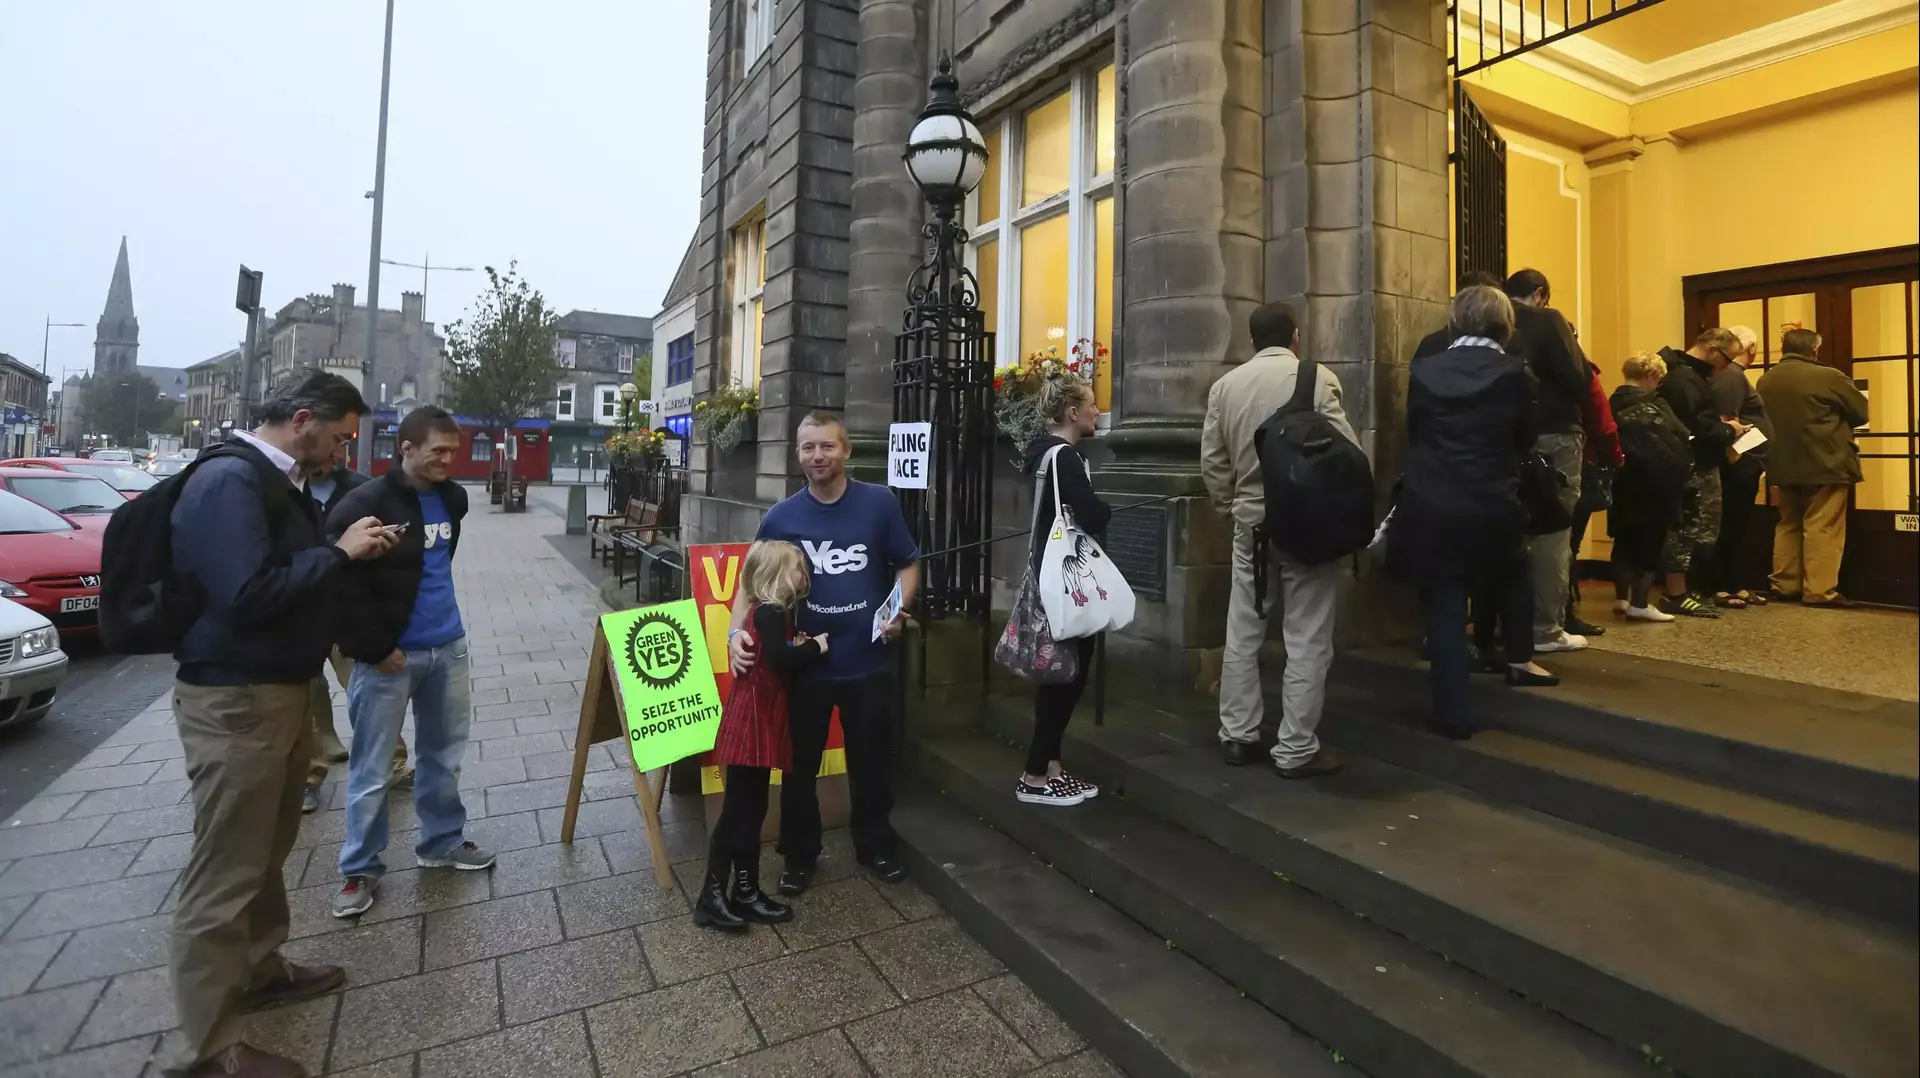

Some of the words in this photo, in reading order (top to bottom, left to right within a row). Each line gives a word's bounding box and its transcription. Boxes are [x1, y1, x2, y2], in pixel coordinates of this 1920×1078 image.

[891, 433, 926, 453] PLING
[424, 522, 452, 549] ye
[801, 540, 868, 575] Yes
[65, 597, 99, 611] DF04
[636, 630, 676, 649] GREEN
[638, 643, 681, 671] YES
[641, 701, 677, 720] SEIZE
[678, 693, 703, 710] THE
[630, 705, 719, 741] OPPORTUNITY
